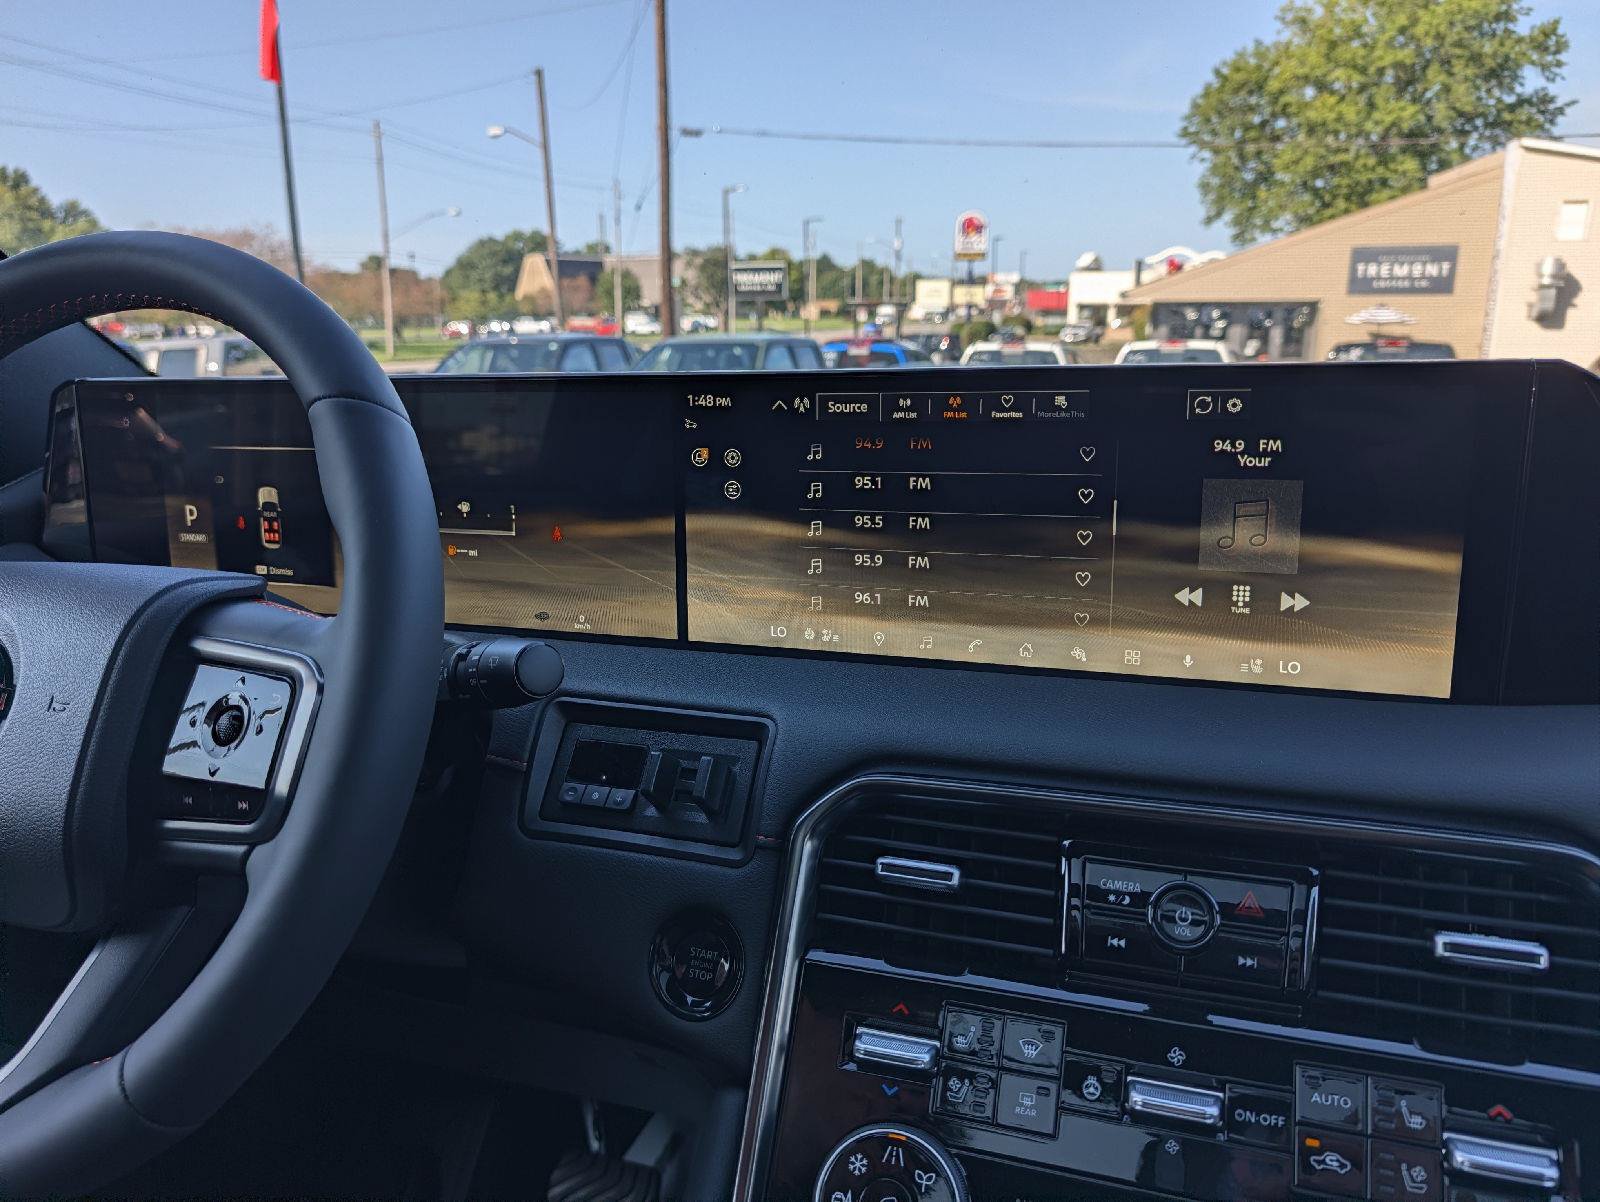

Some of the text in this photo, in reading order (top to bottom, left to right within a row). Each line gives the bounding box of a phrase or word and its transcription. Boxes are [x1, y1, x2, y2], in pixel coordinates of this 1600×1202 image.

[687, 394, 732, 406] 1:48 PM
[828, 401, 868, 412] Source
[856, 438, 932, 450] 94.9 FM
[1214, 440, 1281, 452] 94.9 FM
[1238, 455, 1271, 467] Your
[855, 477, 931, 490] 95.1 FM
[185, 505, 197, 526] P
[855, 516, 930, 529] 95.5 FM
[181, 533, 207, 542] STANDARD
[855, 555, 929, 568] 95.9 FM
[270, 567, 294, 576] Dismiss
[855, 592, 928, 607] 96.1 FM
[771, 626, 786, 637] LO
[1280, 662, 1300, 674] LO
[1100, 878, 1141, 893] CAMERA
[1174, 926, 1191, 937] VOL
[690, 947, 718, 959] START
[689, 969, 712, 981] STOP
[1311, 1092, 1352, 1108] AUTO
[1015, 1107, 1037, 1117] REAR
